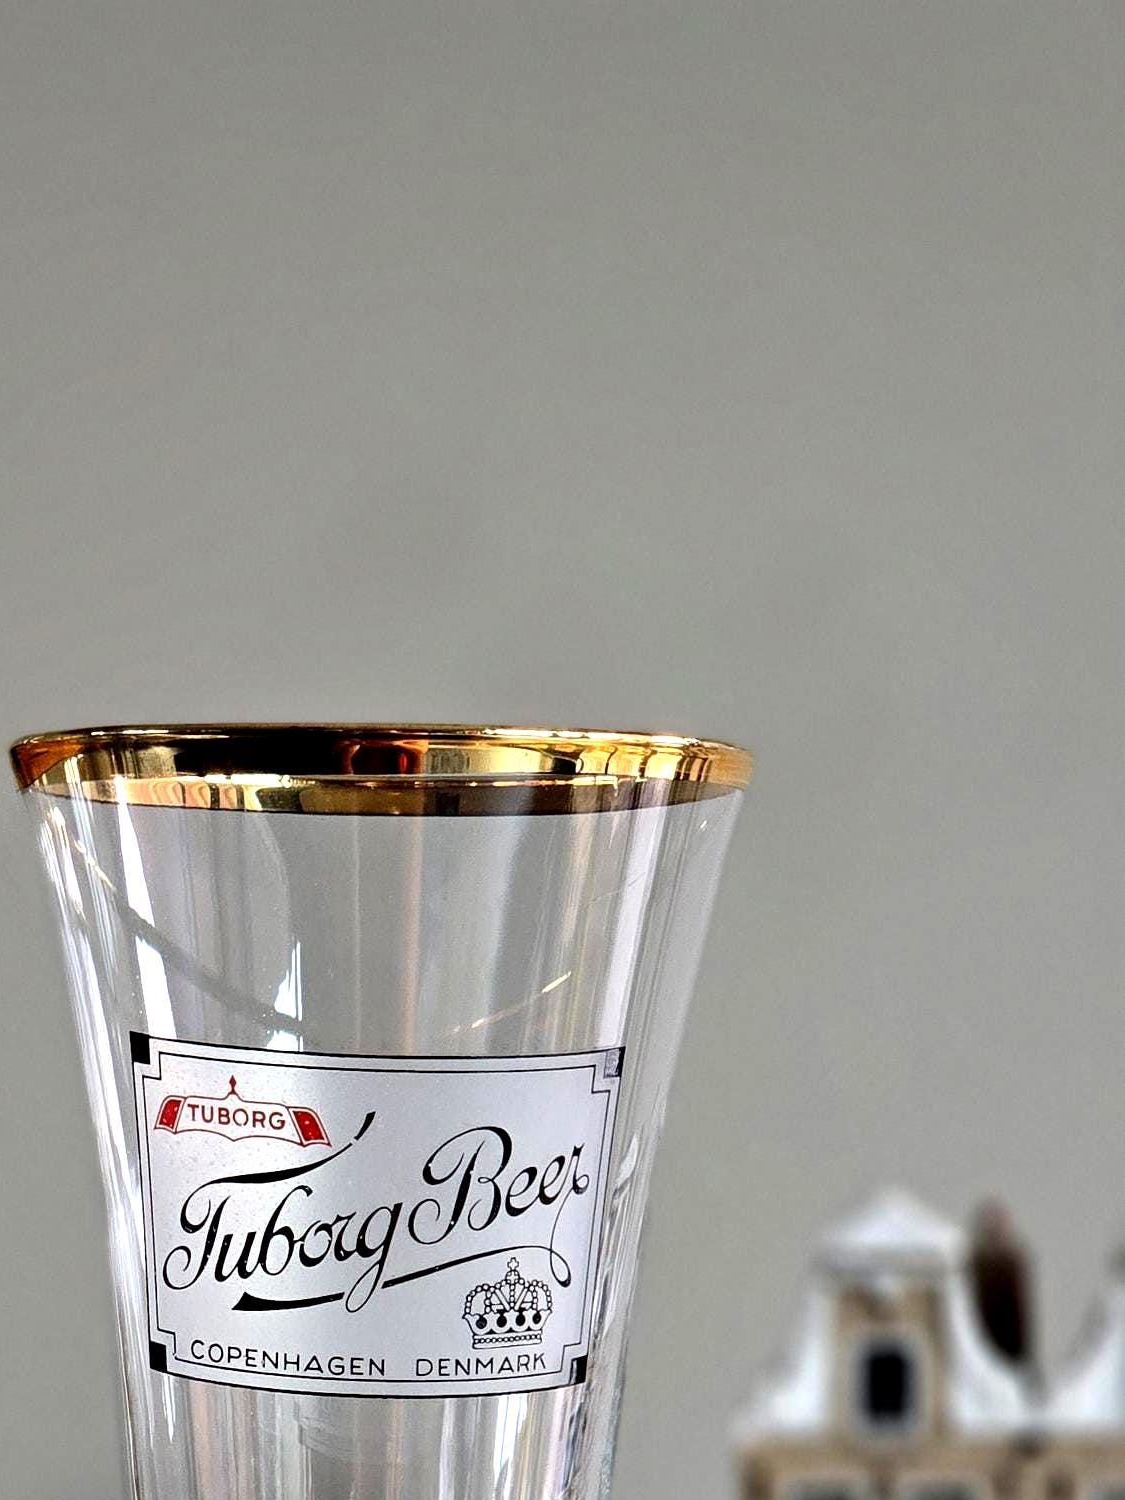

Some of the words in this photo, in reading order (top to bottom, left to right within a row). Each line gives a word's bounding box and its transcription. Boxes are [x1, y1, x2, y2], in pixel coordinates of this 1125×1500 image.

[186, 1103, 286, 1131] TUBORG
[162, 1111, 403, 1312] Tuborg
[407, 1125, 590, 1245] Beer
[190, 1339, 386, 1377] COPENHAGEN
[416, 1351, 548, 1377] DENMARK
